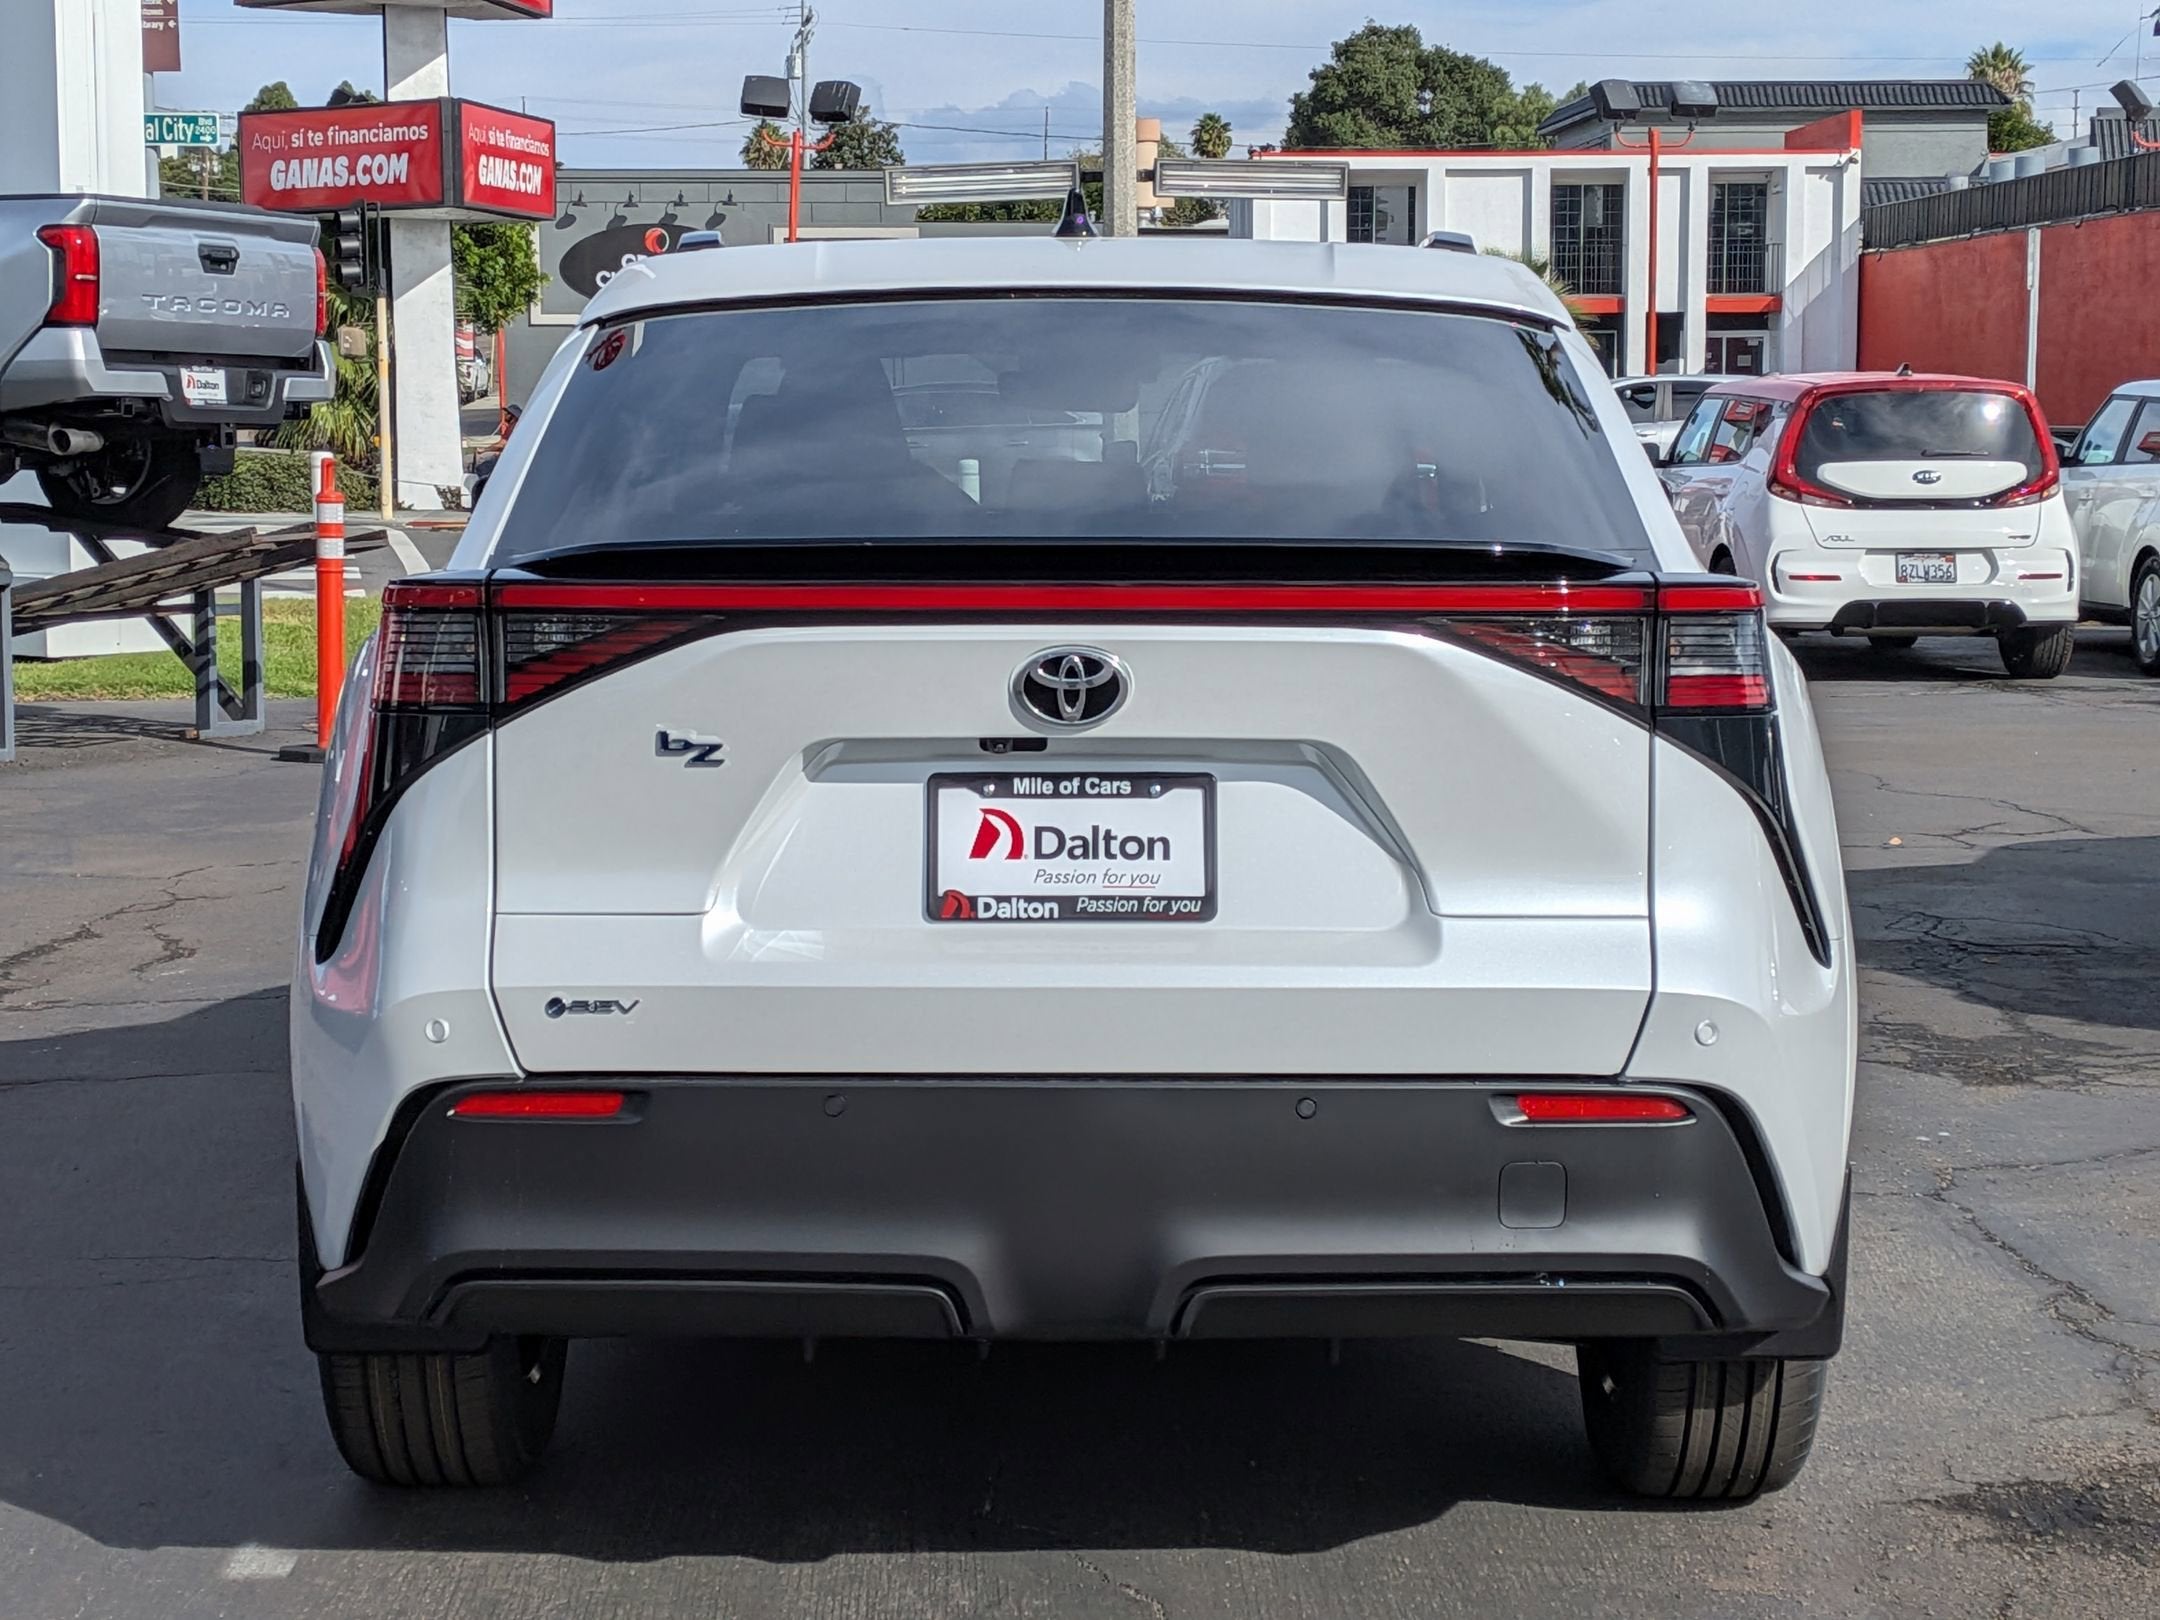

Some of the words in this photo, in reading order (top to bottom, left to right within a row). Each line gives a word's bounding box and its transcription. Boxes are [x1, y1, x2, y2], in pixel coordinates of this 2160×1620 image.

[162, 117, 194, 143] City
[291, 128, 305, 148] sí
[307, 130, 324, 148] te
[327, 123, 429, 147] financiamos
[496, 128, 505, 148] te
[505, 129, 550, 157] financiamos
[270, 152, 409, 191] GANAS.COM
[478, 154, 543, 195] GANAS.COM
[141, 294, 290, 318] TACOMA
[1900, 564, 1953, 580] 8ZLW356
[1013, 777, 1055, 795] Mile
[1059, 777, 1081, 795] of
[1085, 777, 1132, 795] Cars
[1033, 825, 1171, 861] Dalton
[1033, 868, 1097, 885] Passion
[1102, 868, 1127, 886] for
[1129, 872, 1161, 886] you
[977, 897, 1059, 919] Dalton
[1076, 897, 1140, 913] Passion
[1142, 897, 1167, 914] for
[1170, 899, 1201, 915] you
